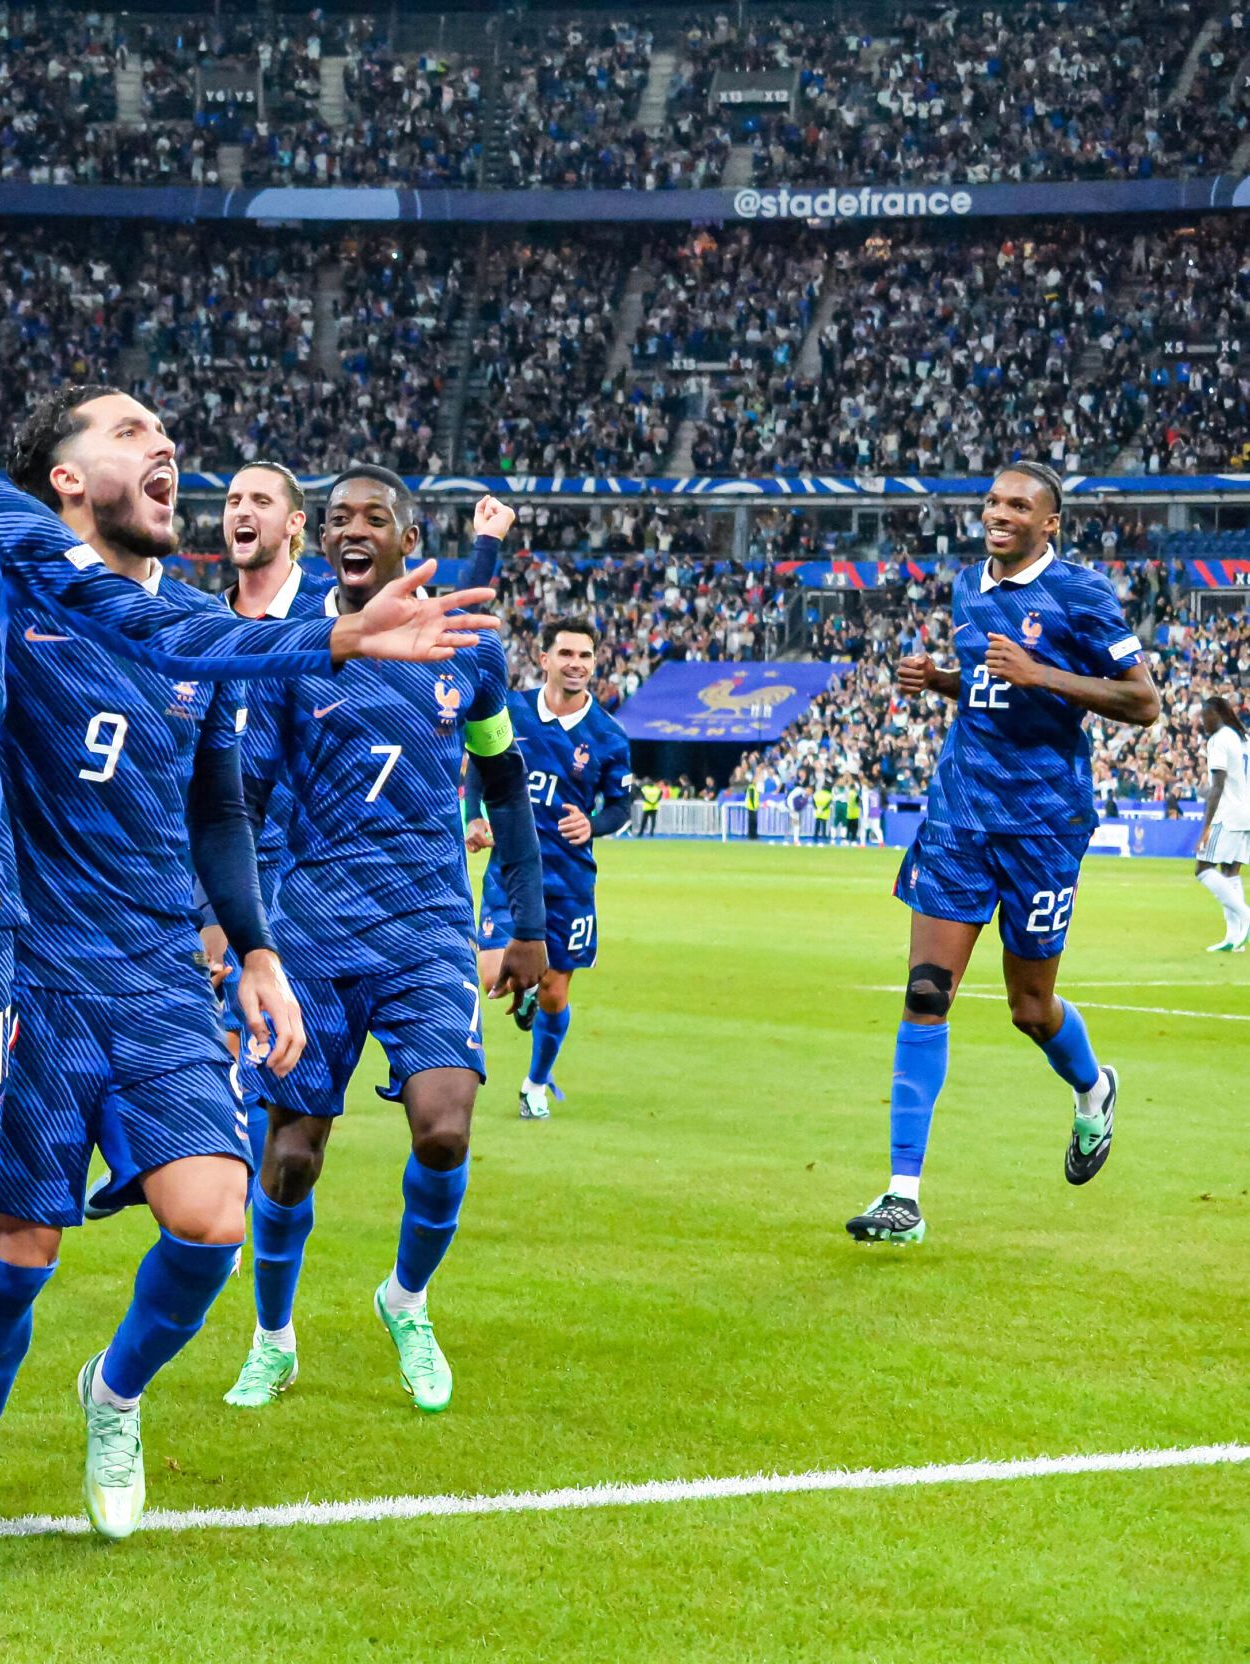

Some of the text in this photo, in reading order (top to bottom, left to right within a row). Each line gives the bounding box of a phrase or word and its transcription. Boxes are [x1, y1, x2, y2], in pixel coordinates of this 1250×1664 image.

[235, 91, 254, 102] Y5
[734, 188, 972, 218] @stadefrance
[1165, 340, 1240, 353] X5 X4
[969, 664, 1012, 708] 22
[78, 711, 128, 782] 9
[364, 745, 402, 803] 7
[528, 770, 558, 806] 21
[1026, 886, 1074, 931] 22
[567, 914, 594, 950] 21
[462, 980, 480, 1032] 7
